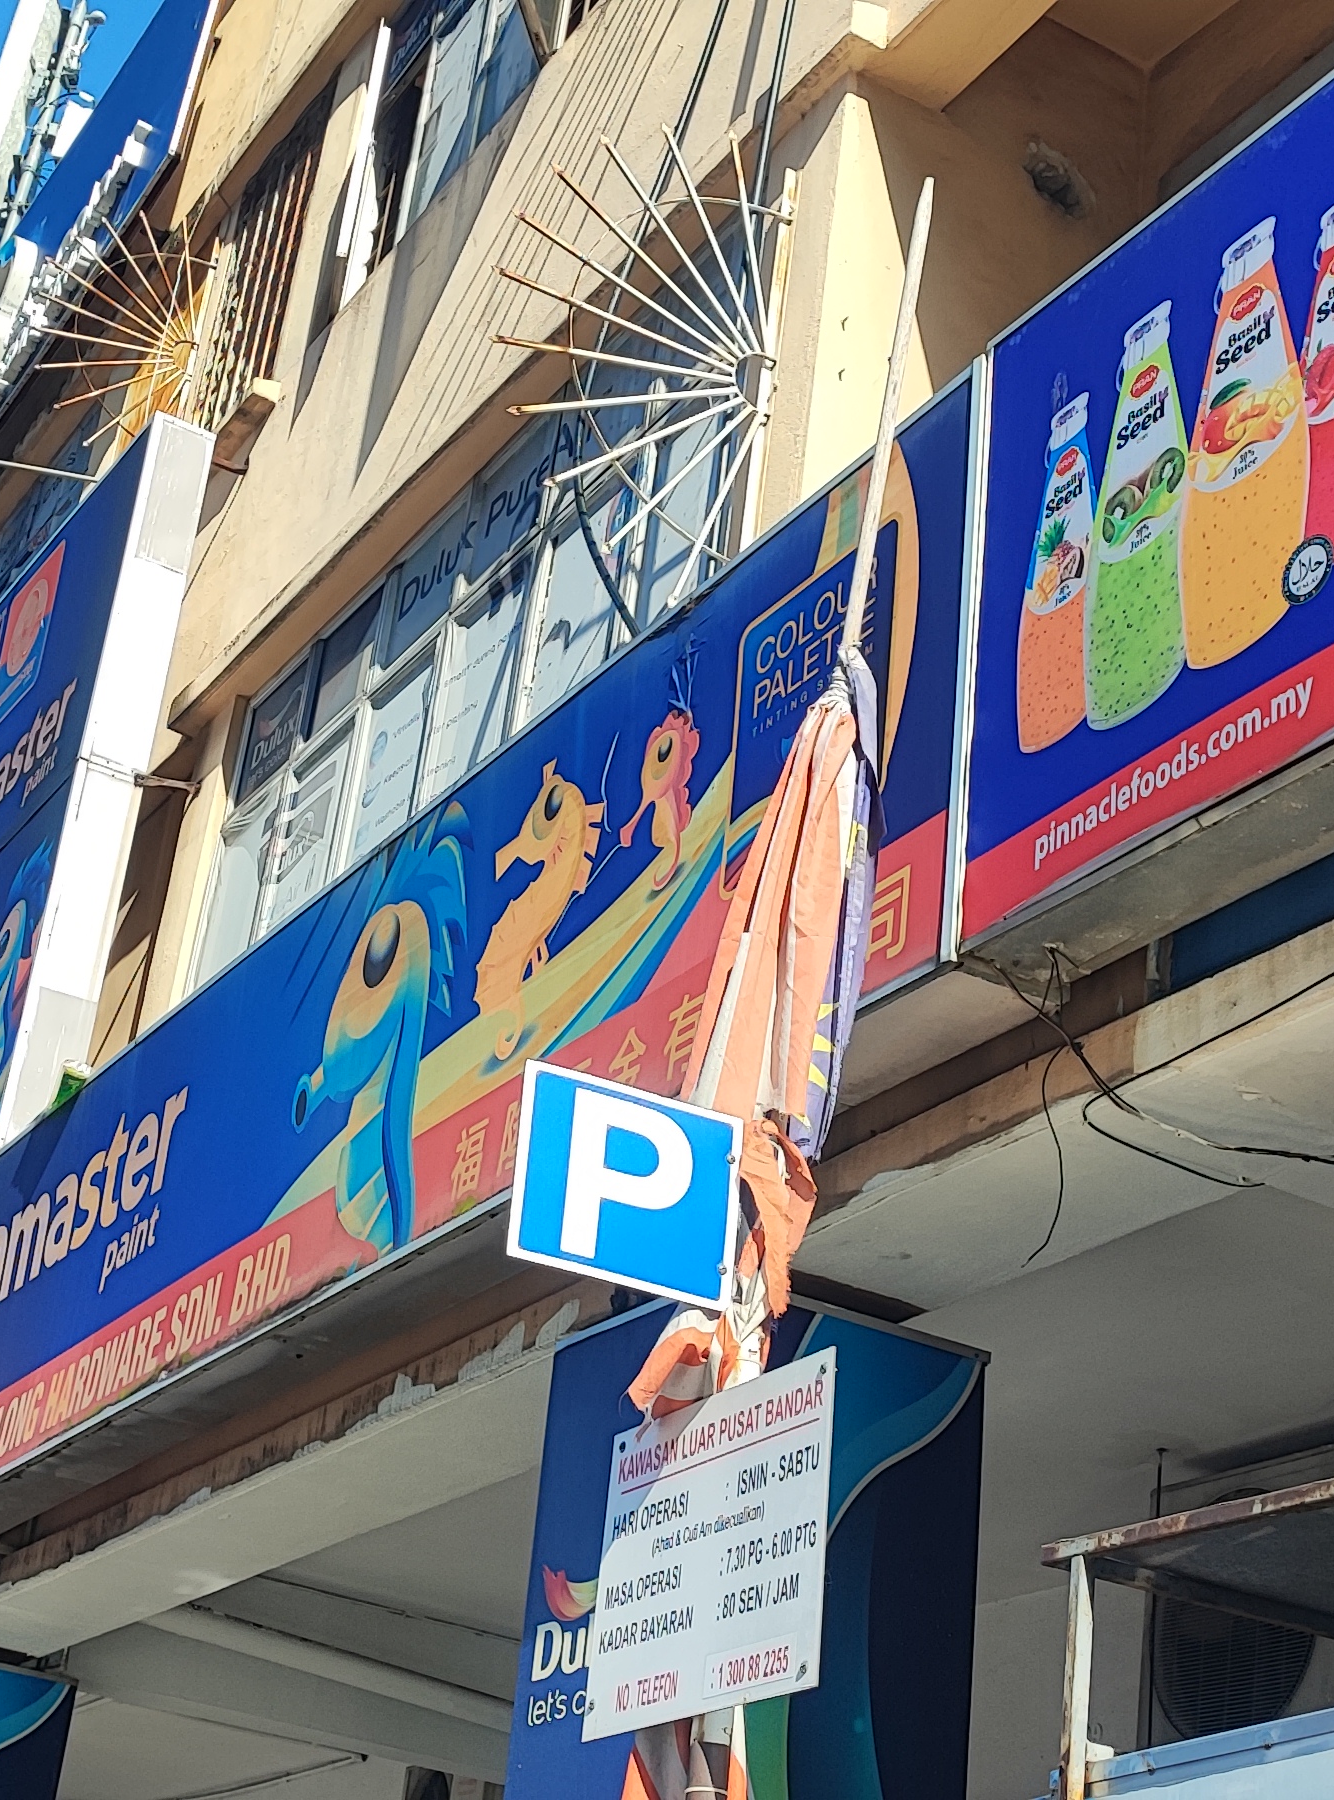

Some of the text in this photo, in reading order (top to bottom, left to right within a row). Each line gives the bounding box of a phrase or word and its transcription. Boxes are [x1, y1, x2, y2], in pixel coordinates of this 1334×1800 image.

[1228, 313, 1262, 348] Basil
[1233, 289, 1261, 315] PRAN
[1216, 318, 1271, 374] Seed
[1127, 393, 1156, 424] Basil
[1133, 370, 1158, 396] PRAN
[1117, 401, 1165, 450] Seed
[1053, 471, 1078, 496] Basil
[1057, 451, 1078, 473] PRAN
[1045, 479, 1083, 518] Seed
[397, 520, 478, 623] Dulux
[753, 596, 874, 719] PALETE
[250, 714, 298, 770] Dulux
[752, 691, 808, 738] TINTING
[20, 746, 58, 808] paint
[1034, 676, 1314, 871] pinnaclefoods.com.my
[559, 1086, 694, 1259] P
[97, 1203, 160, 1294] paint
[39, 1305, 168, 1434] HARDWARE
[164, 1271, 224, 1362] SDN.
[228, 1233, 293, 1328] BHD.
[618, 1380, 823, 1484] KAWASAN LUAR PUSAT BANDAR
[612, 1509, 638, 1541] HARI
[641, 1490, 689, 1531] OPERASI
[736, 1462, 768, 1498] ISNIN
[778, 1442, 820, 1482] SABTU
[698, 1520, 713, 1538] Am
[604, 1580, 633, 1611] MASA
[636, 1564, 682, 1601] OPERASI
[748, 1538, 763, 1565] PG
[771, 1532, 792, 1559] 6.00
[795, 1520, 817, 1552] PTG
[599, 1622, 637, 1654] KADAR
[640, 1605, 694, 1642] BAYARAN
[739, 1584, 763, 1615] SEN
[772, 1573, 800, 1604] JAM
[531, 1613, 595, 1682] Dul
[636, 1670, 679, 1707] TELEFON
[726, 1656, 746, 1687] 300
[747, 1653, 760, 1681] 88
[762, 1645, 789, 1678] 2255
[527, 1689, 568, 1727] let's
